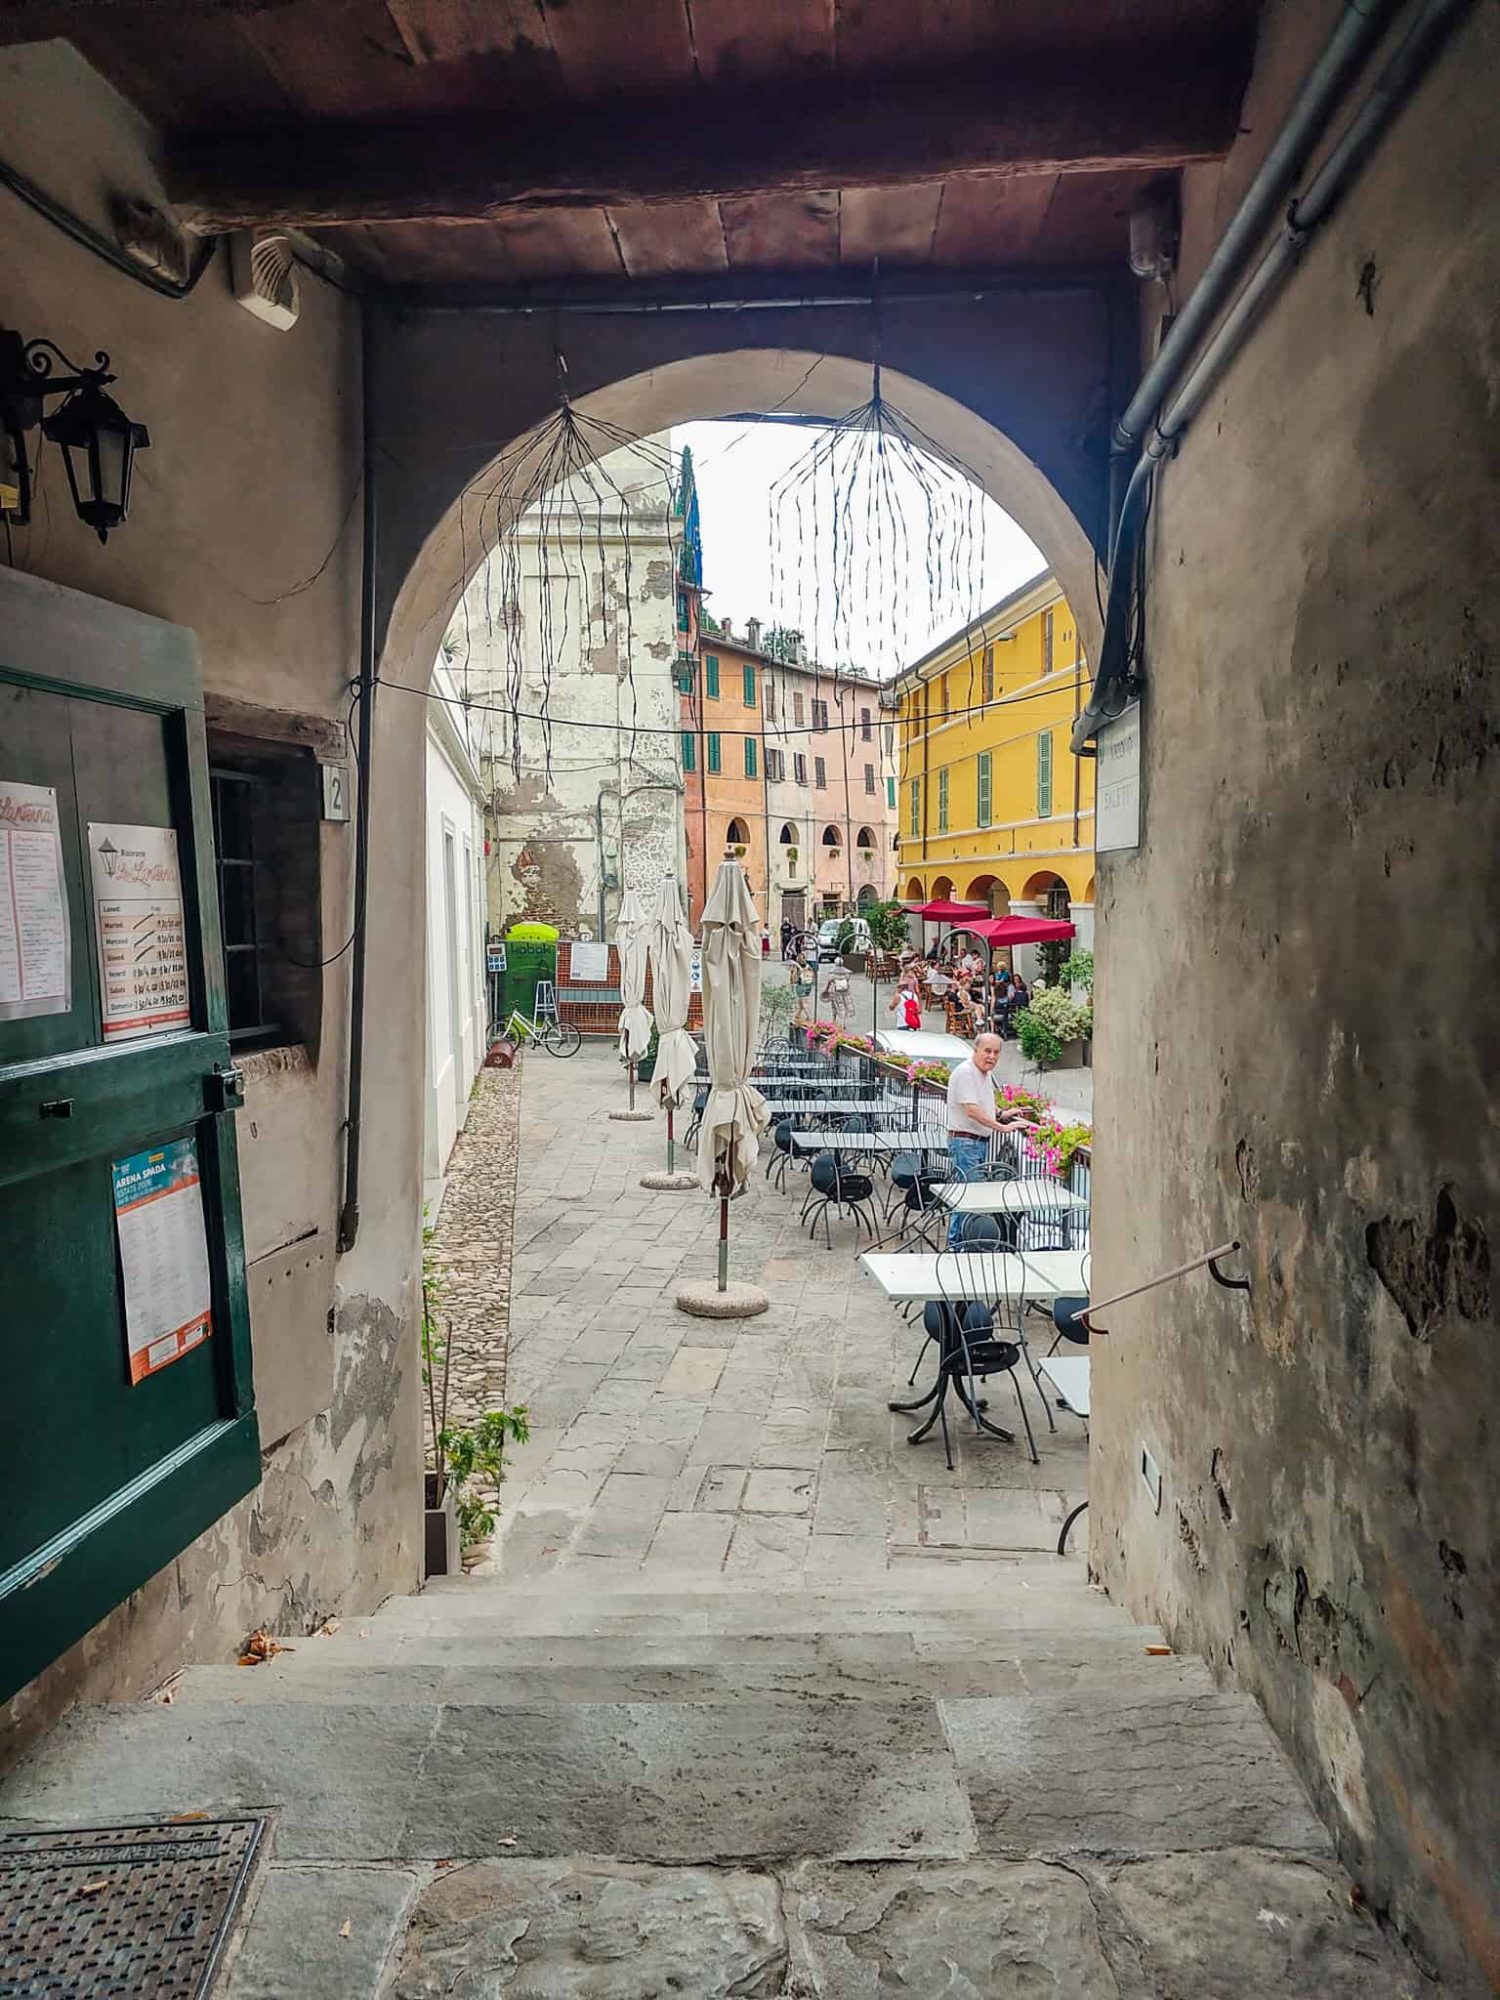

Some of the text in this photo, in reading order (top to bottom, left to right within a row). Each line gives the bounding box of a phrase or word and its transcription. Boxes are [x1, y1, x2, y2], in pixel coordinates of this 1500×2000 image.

[332, 777, 341, 810] 2
[116, 1172, 142, 1189] ARENA
[142, 1163, 166, 1179] SPADA
